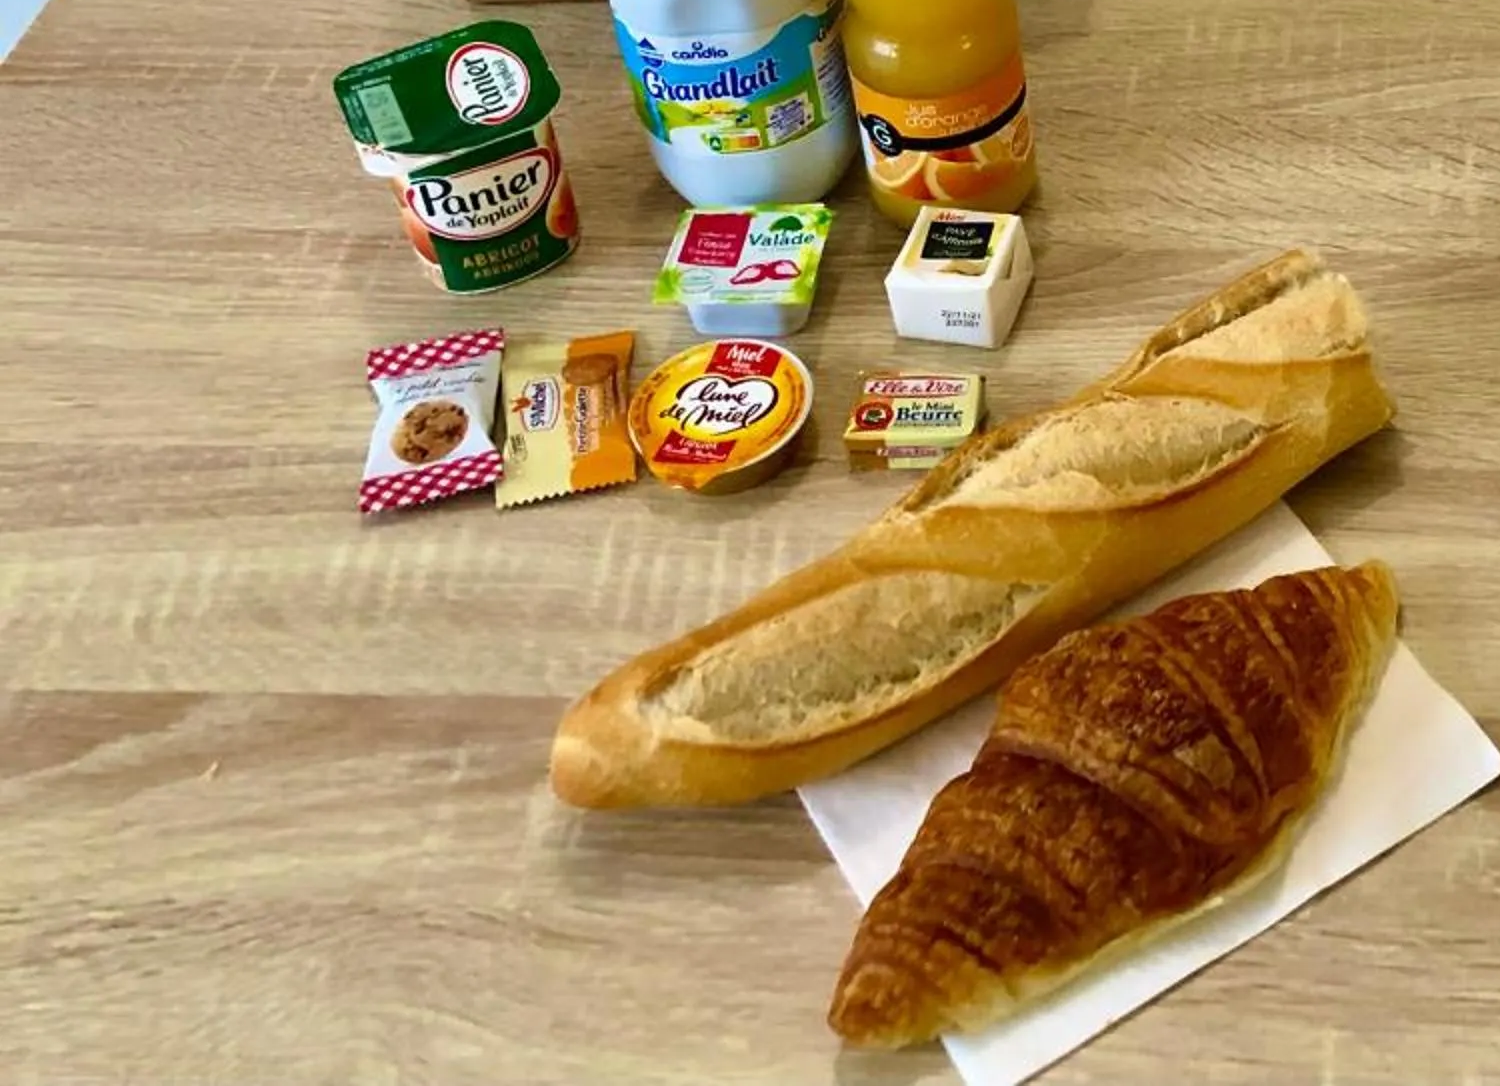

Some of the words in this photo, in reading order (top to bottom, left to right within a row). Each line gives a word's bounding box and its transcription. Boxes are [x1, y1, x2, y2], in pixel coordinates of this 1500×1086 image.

[671, 44, 729, 60] candia
[460, 57, 509, 124] Panier
[873, 120, 893, 146] G
[411, 160, 541, 217] Panier
[446, 218, 464, 229] de
[464, 196, 530, 228] Yoplait
[749, 232, 815, 248] Valade
[463, 234, 540, 269] ABRICOT
[726, 344, 767, 363] Miel
[659, 403, 686, 421] de
[896, 407, 964, 422] Beurre
